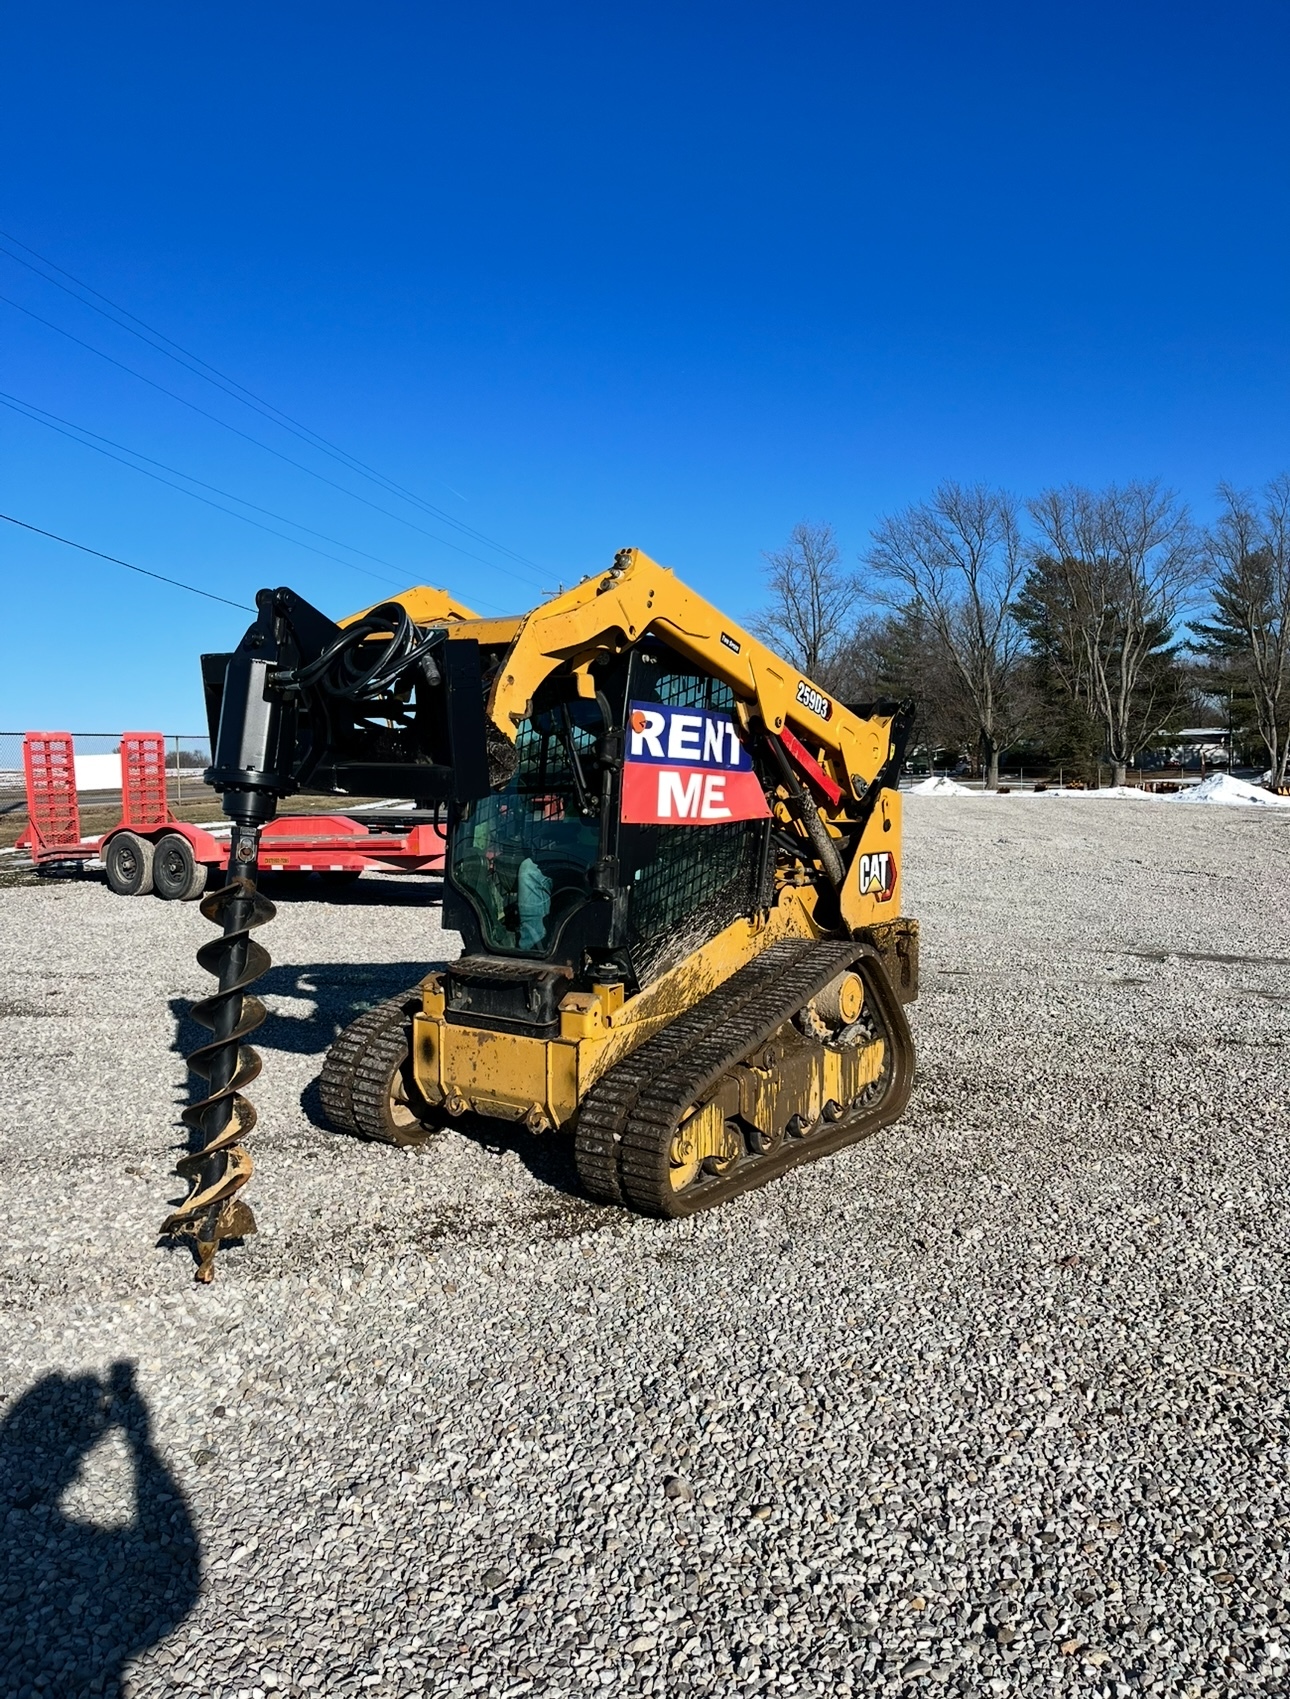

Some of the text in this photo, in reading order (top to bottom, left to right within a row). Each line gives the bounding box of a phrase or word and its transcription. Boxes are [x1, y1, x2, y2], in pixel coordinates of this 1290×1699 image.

[797, 681, 828, 719] 259D3
[631, 709, 740, 765] RENT
[657, 771, 732, 818] ME
[860, 853, 889, 894] CAT
